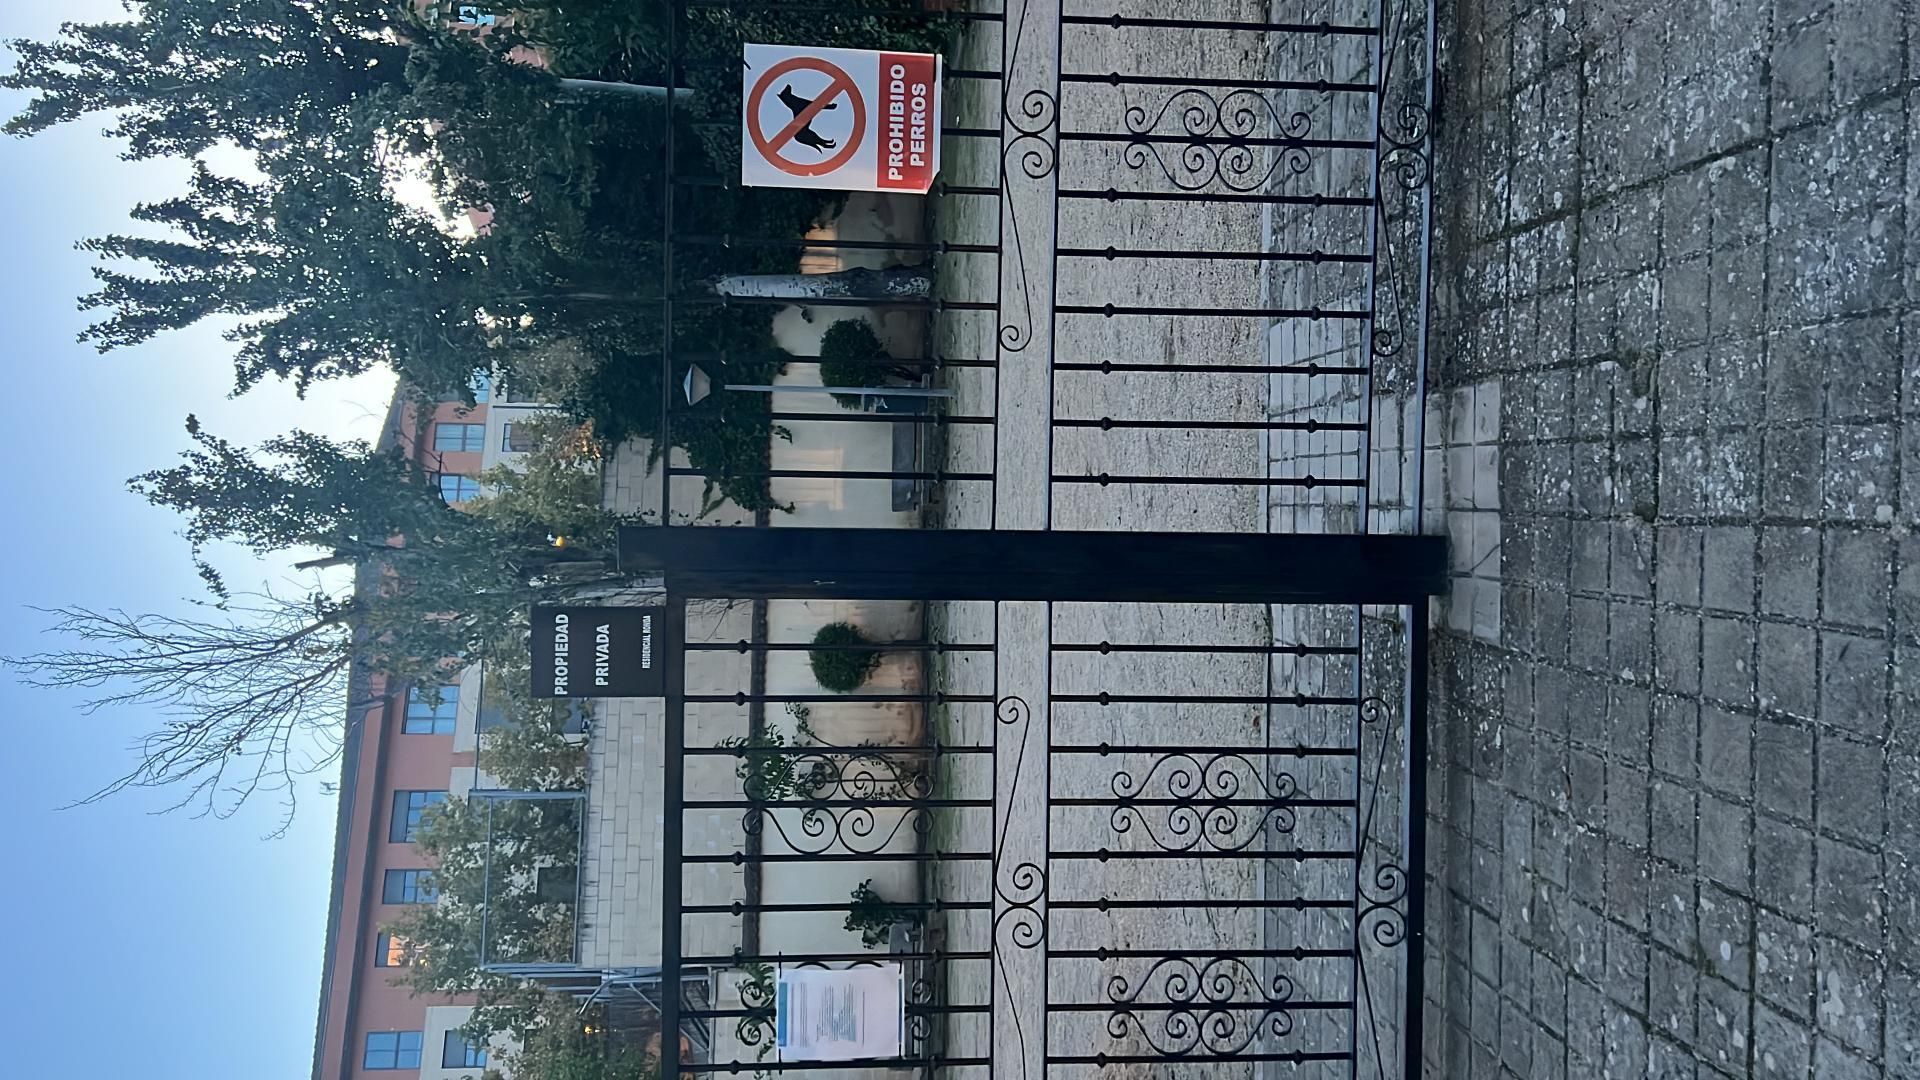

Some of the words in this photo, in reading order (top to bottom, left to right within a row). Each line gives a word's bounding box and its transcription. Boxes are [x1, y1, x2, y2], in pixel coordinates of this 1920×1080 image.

[888, 64, 905, 181] PROHIBIDO
[910, 82, 926, 167] PERROS
[554, 614, 569, 695] PROPIEDAD
[595, 624, 610, 686] PRIVADA
[641, 634, 651, 669] RESIDENCIAL
